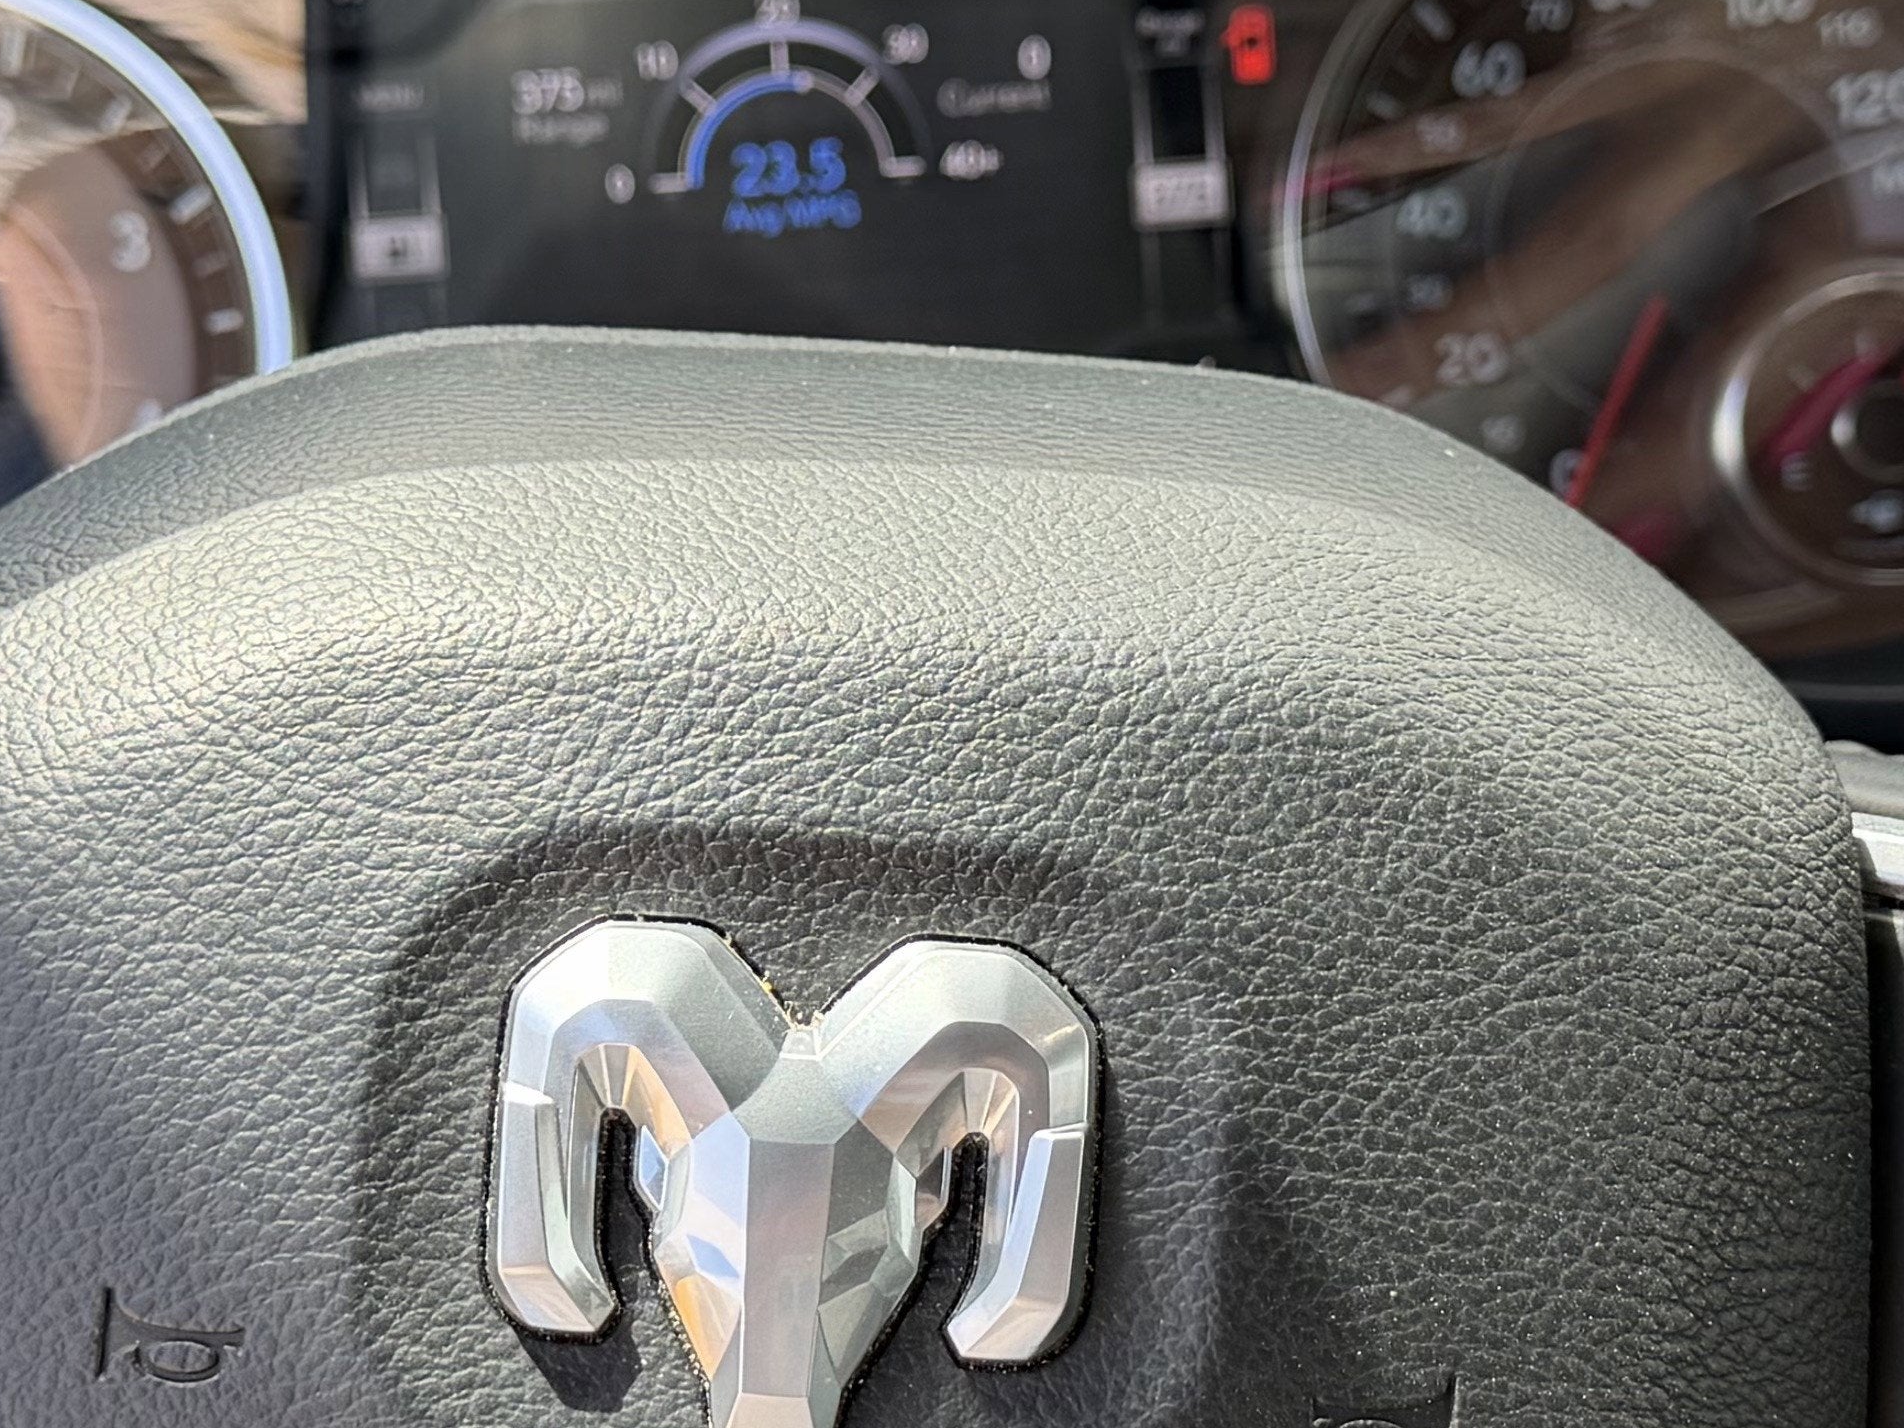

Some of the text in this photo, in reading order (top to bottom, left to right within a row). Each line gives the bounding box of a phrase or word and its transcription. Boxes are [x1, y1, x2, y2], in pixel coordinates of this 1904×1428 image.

[1451, 40, 1527, 98] 60
[730, 136, 847, 198] 23.5
[109, 209, 152, 273] 3
